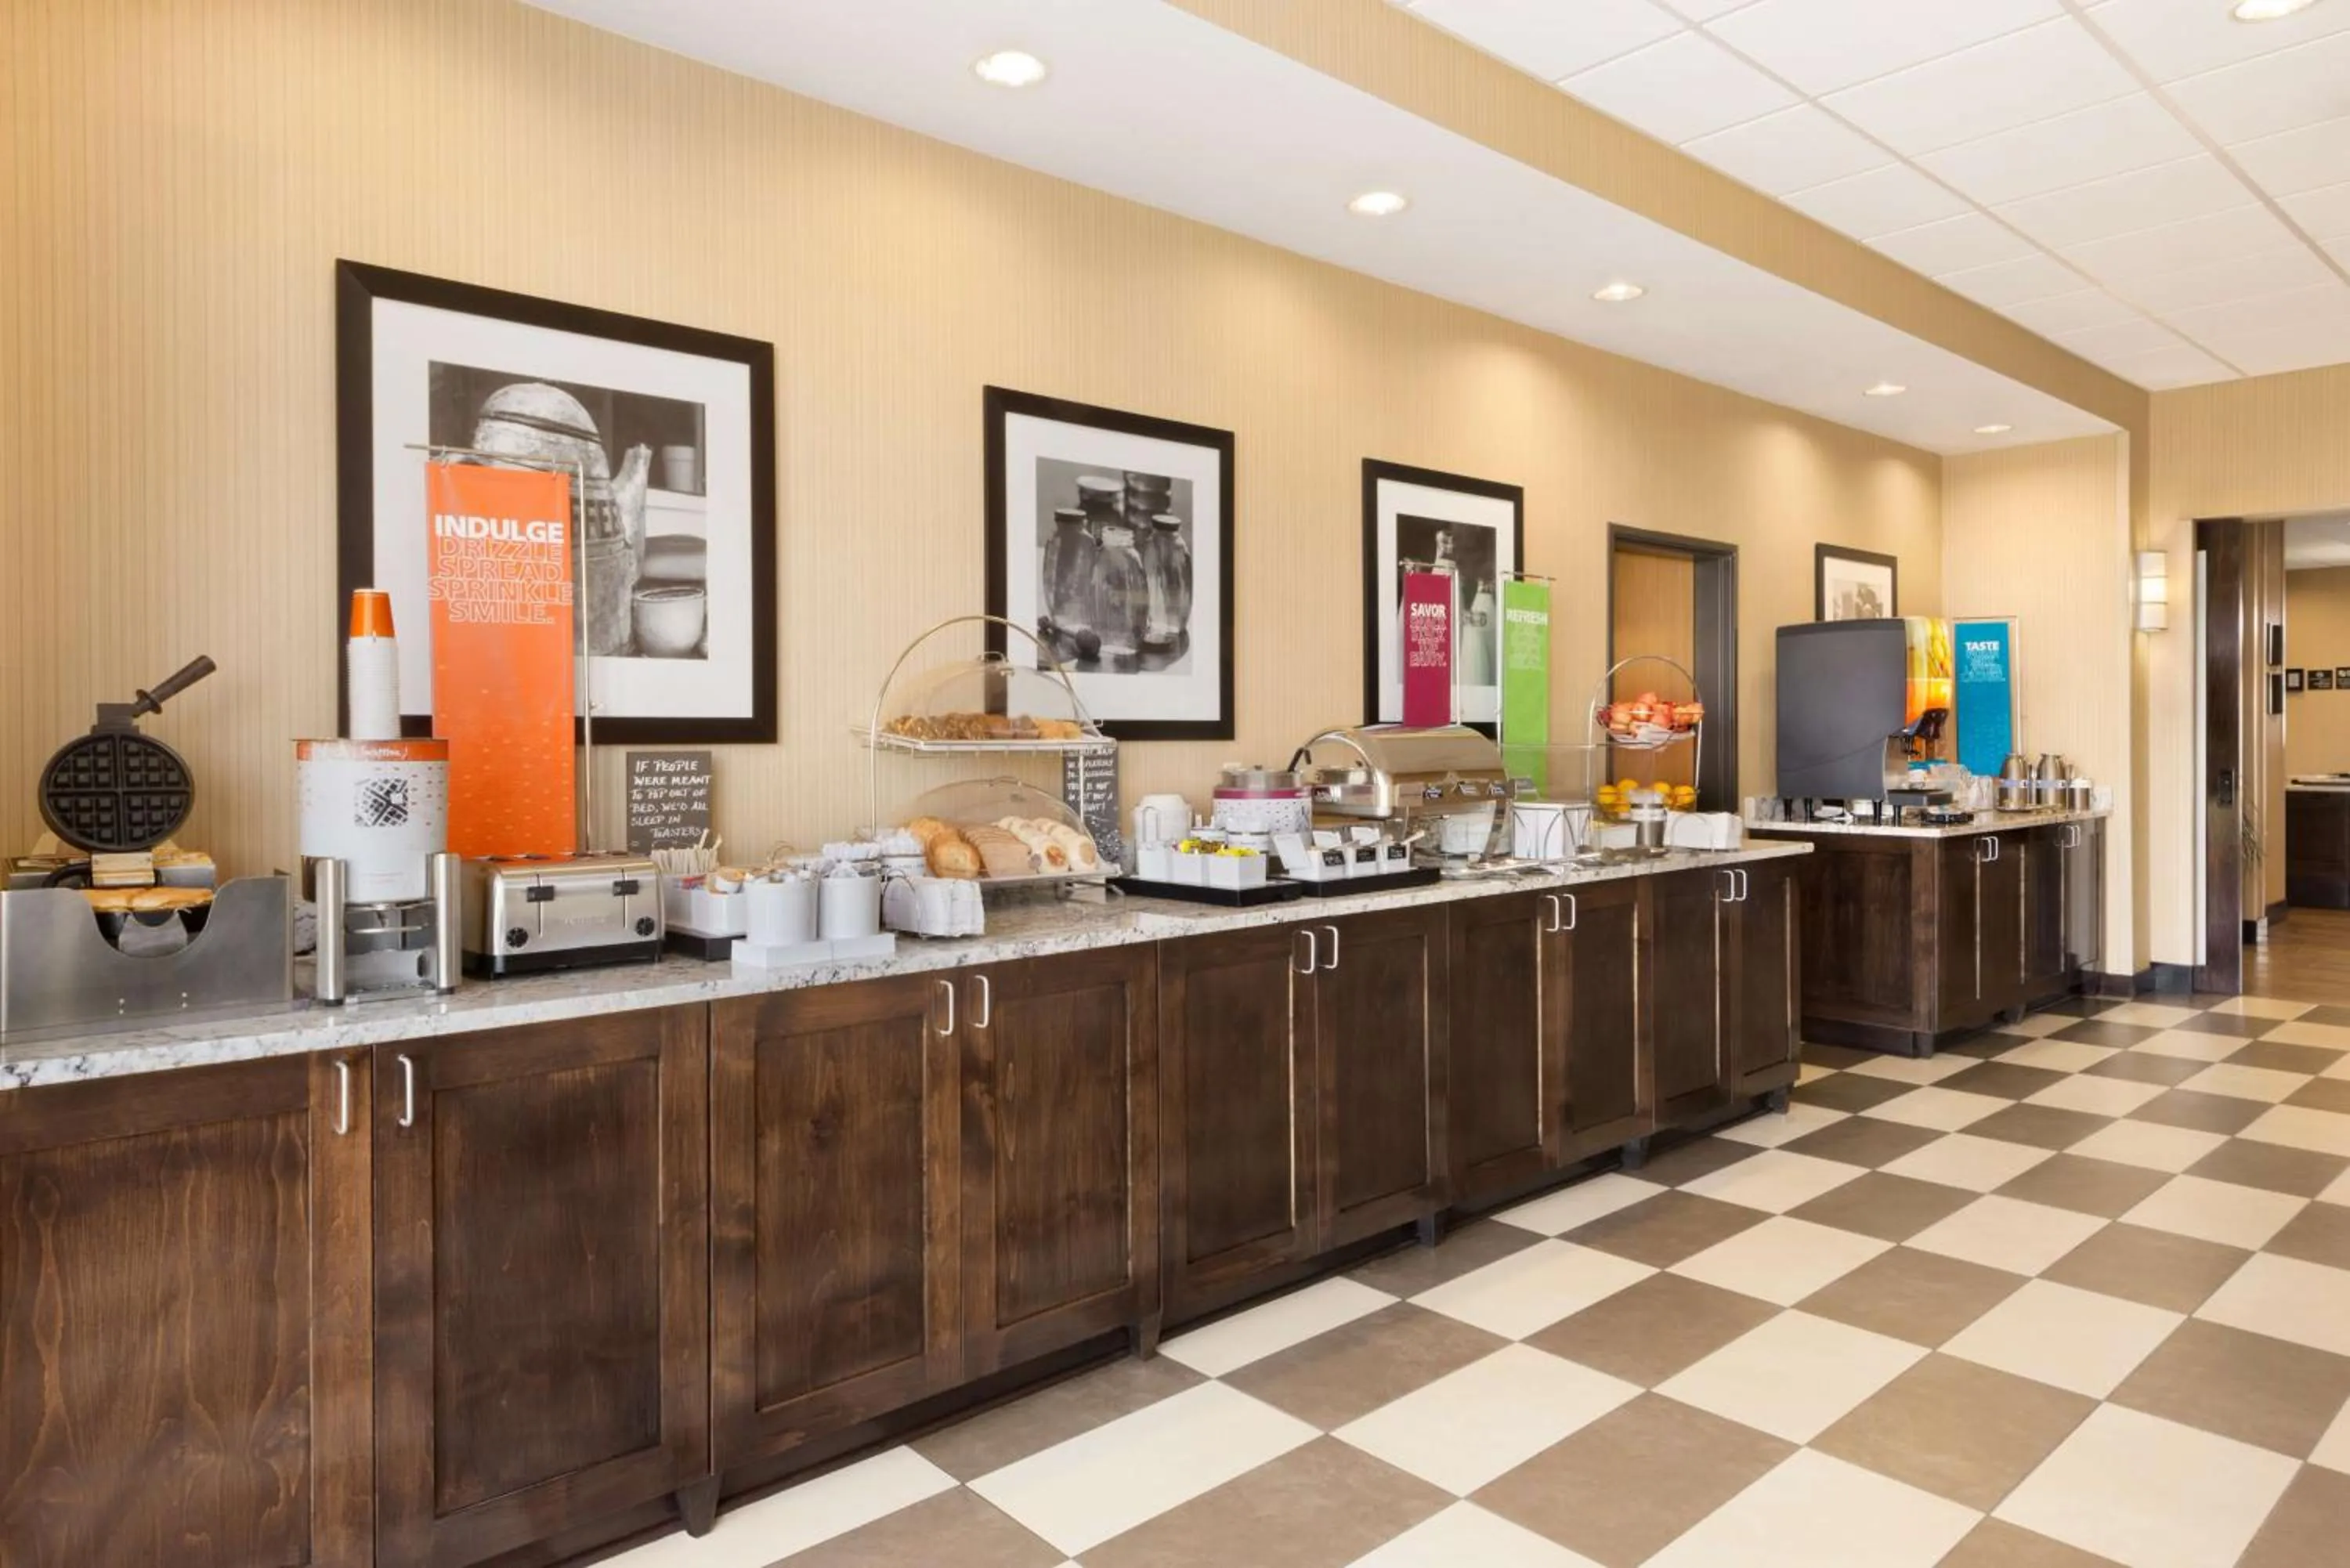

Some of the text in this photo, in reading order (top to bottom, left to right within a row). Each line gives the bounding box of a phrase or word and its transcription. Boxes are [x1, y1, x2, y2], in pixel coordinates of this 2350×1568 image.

[435, 514, 564, 543] INDULGE
[438, 536, 563, 564] DRIZZLE
[437, 555, 563, 583] SPREAD
[428, 576, 574, 605] SPRINKLE
[449, 600, 555, 624] SMILE.
[1410, 602, 1446, 618] SAVOR
[1506, 608, 1549, 625] REFRESH
[1965, 641, 2000, 652] TASTE
[635, 759, 699, 772] IF PEOPLE
[634, 775, 711, 786] WERE MEANT
[631, 814, 681, 826] SLEEP IN
